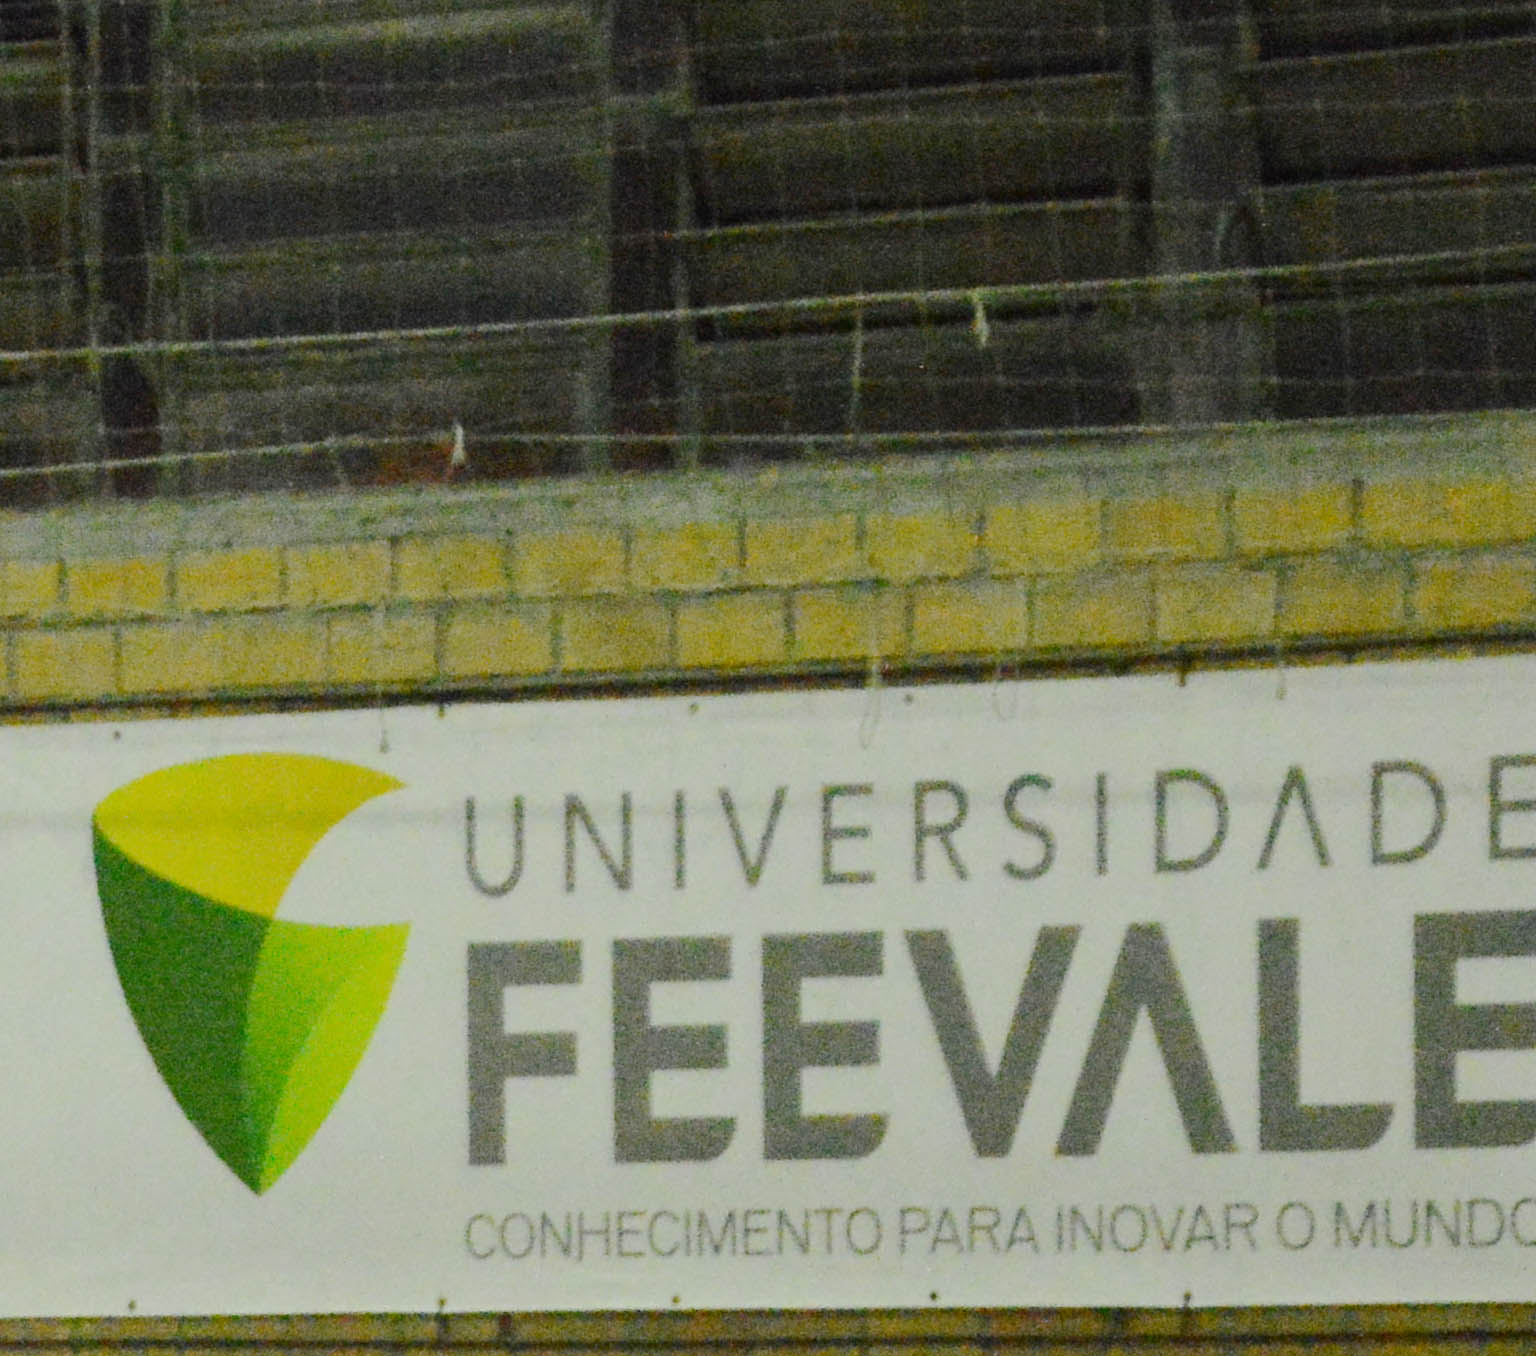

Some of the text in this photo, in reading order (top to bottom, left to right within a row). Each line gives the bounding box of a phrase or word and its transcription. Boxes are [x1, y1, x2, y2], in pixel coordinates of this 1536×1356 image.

[464, 753, 1536, 898] UNIVERSIDADE
[465, 907, 1536, 1168] FEEVALE
[464, 1206, 883, 1262] CONHECIMENTO
[897, 1203, 1040, 1255] PARA
[1054, 1200, 1261, 1255] INOVAR
[1275, 1200, 1318, 1251] O
